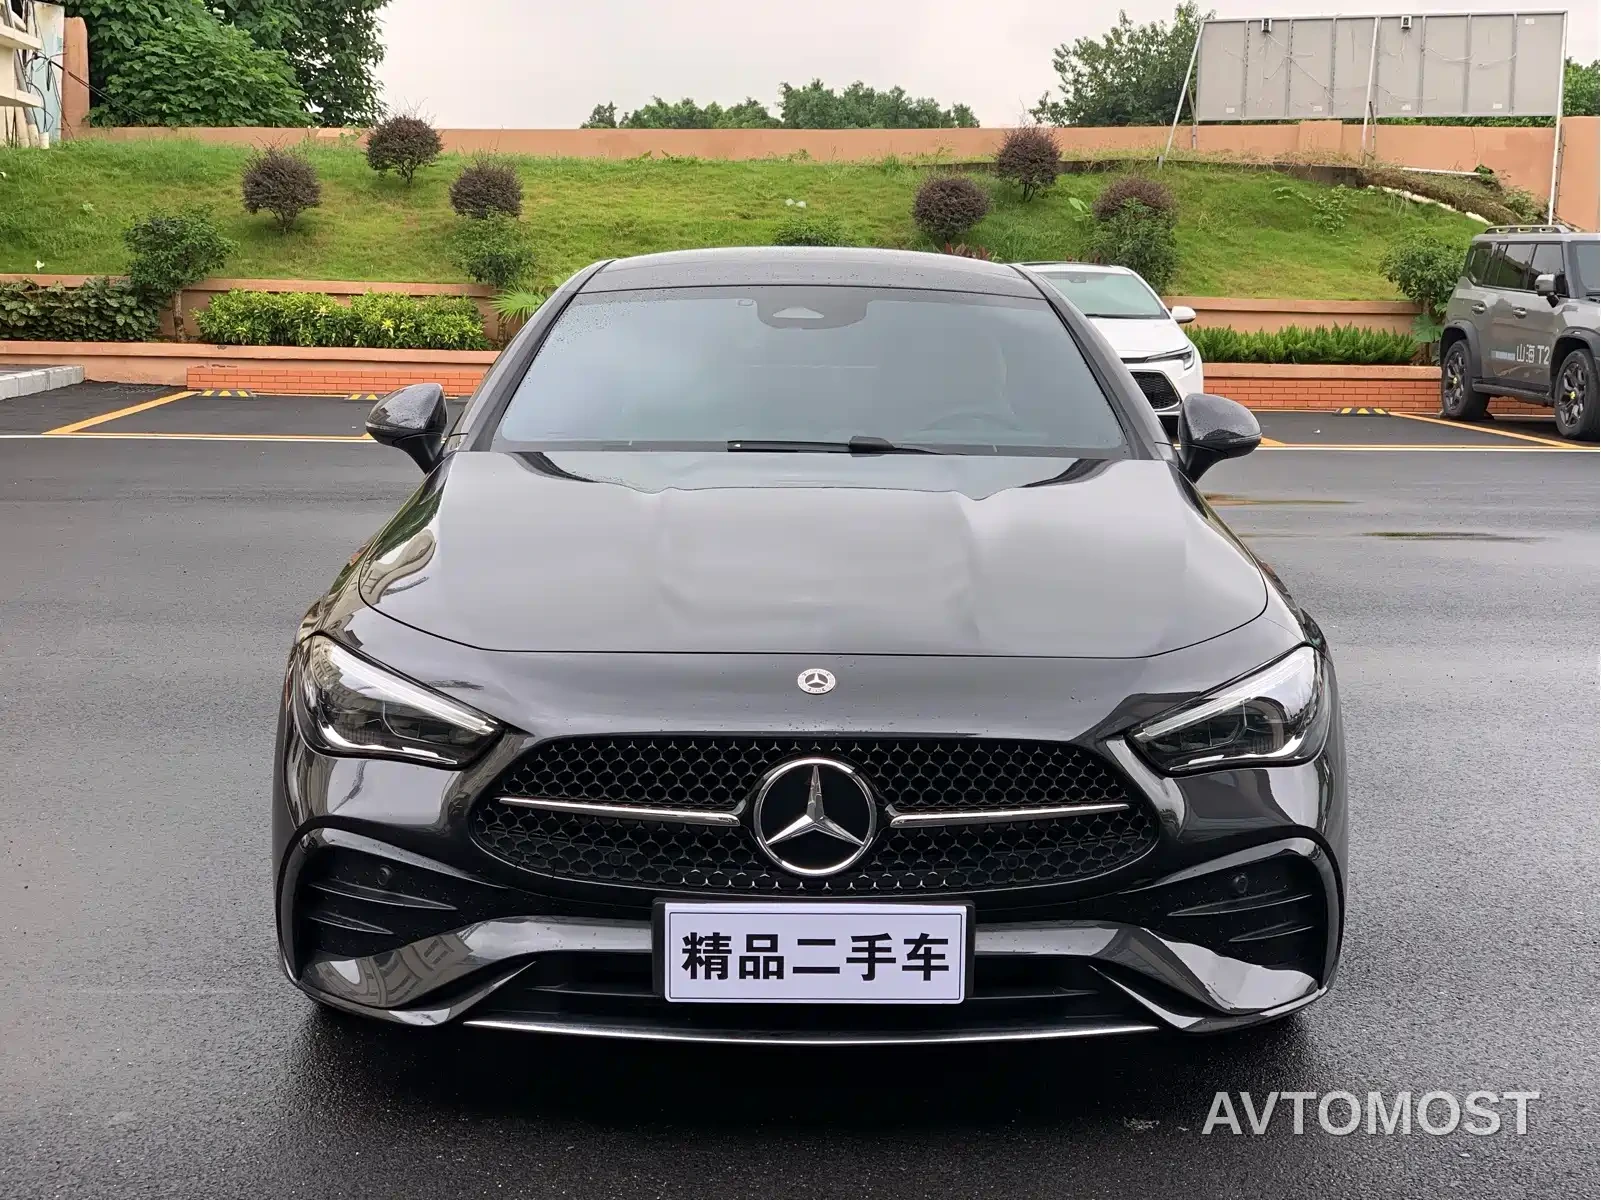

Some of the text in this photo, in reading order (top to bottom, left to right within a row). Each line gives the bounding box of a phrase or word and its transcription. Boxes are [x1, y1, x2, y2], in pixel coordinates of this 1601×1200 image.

[1537, 344, 1550, 365] T2
[681, 932, 950, 981] 精品二手车
